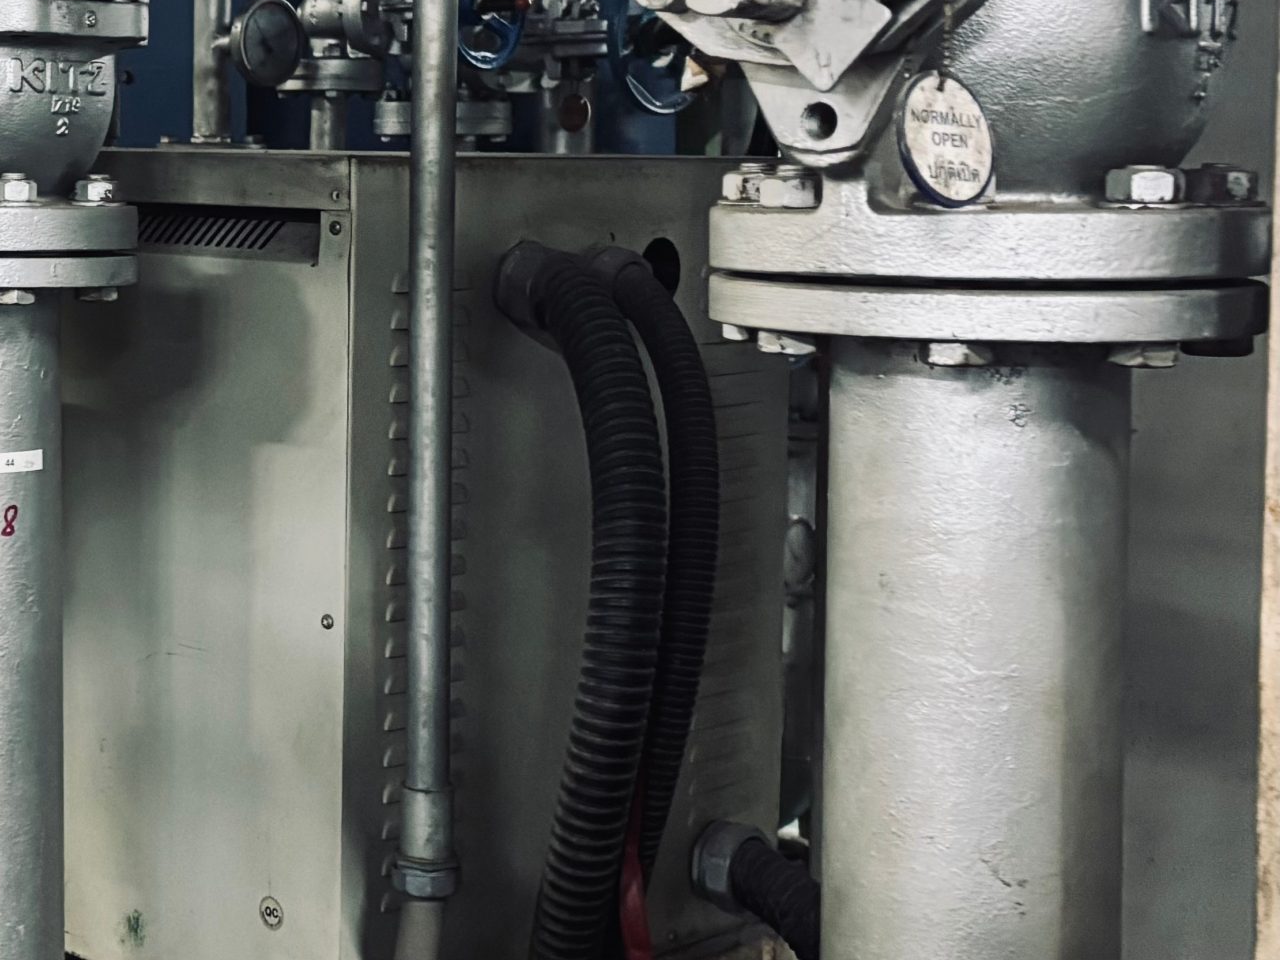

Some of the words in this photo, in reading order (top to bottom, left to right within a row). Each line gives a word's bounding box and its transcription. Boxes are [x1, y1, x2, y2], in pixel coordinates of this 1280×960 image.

[8, 58, 107, 97] KITZ
[910, 108, 982, 130] NORMALLY
[932, 131, 969, 149] OPEN
[5, 458, 15, 467] 44
[264, 906, 279, 919] QC
